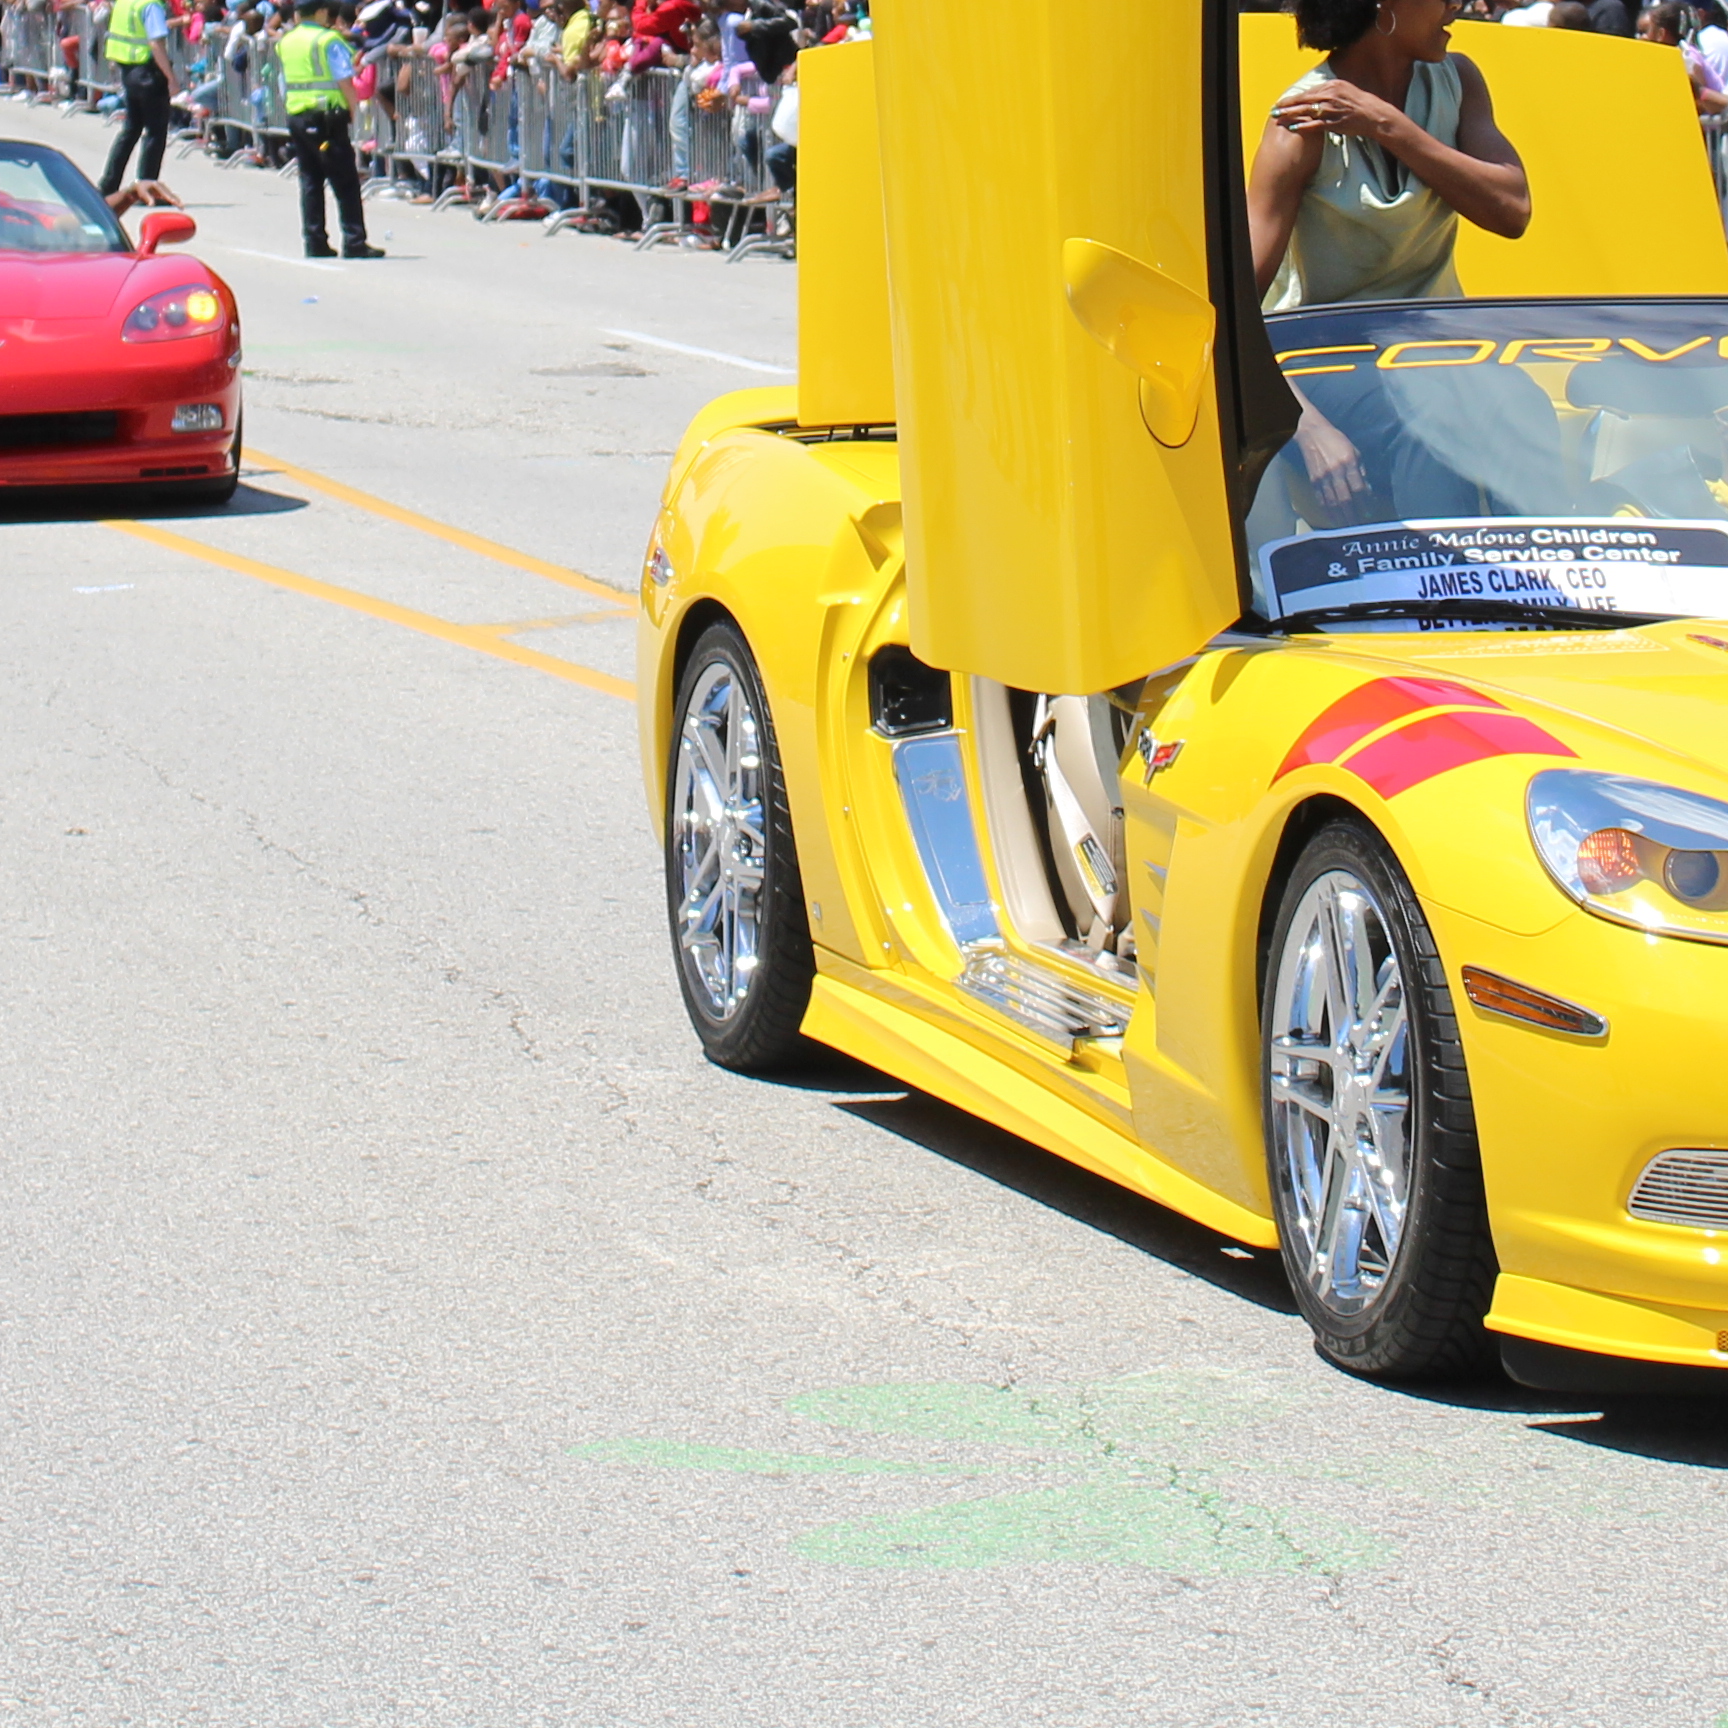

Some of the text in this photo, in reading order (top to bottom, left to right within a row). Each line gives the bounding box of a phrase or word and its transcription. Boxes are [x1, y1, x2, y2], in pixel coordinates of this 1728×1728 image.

[1342, 527, 1658, 557] Annie Malone Children
[1327, 546, 1682, 578] & Family Service Center
[1417, 567, 1607, 599] JAMES CLARK, CEO
